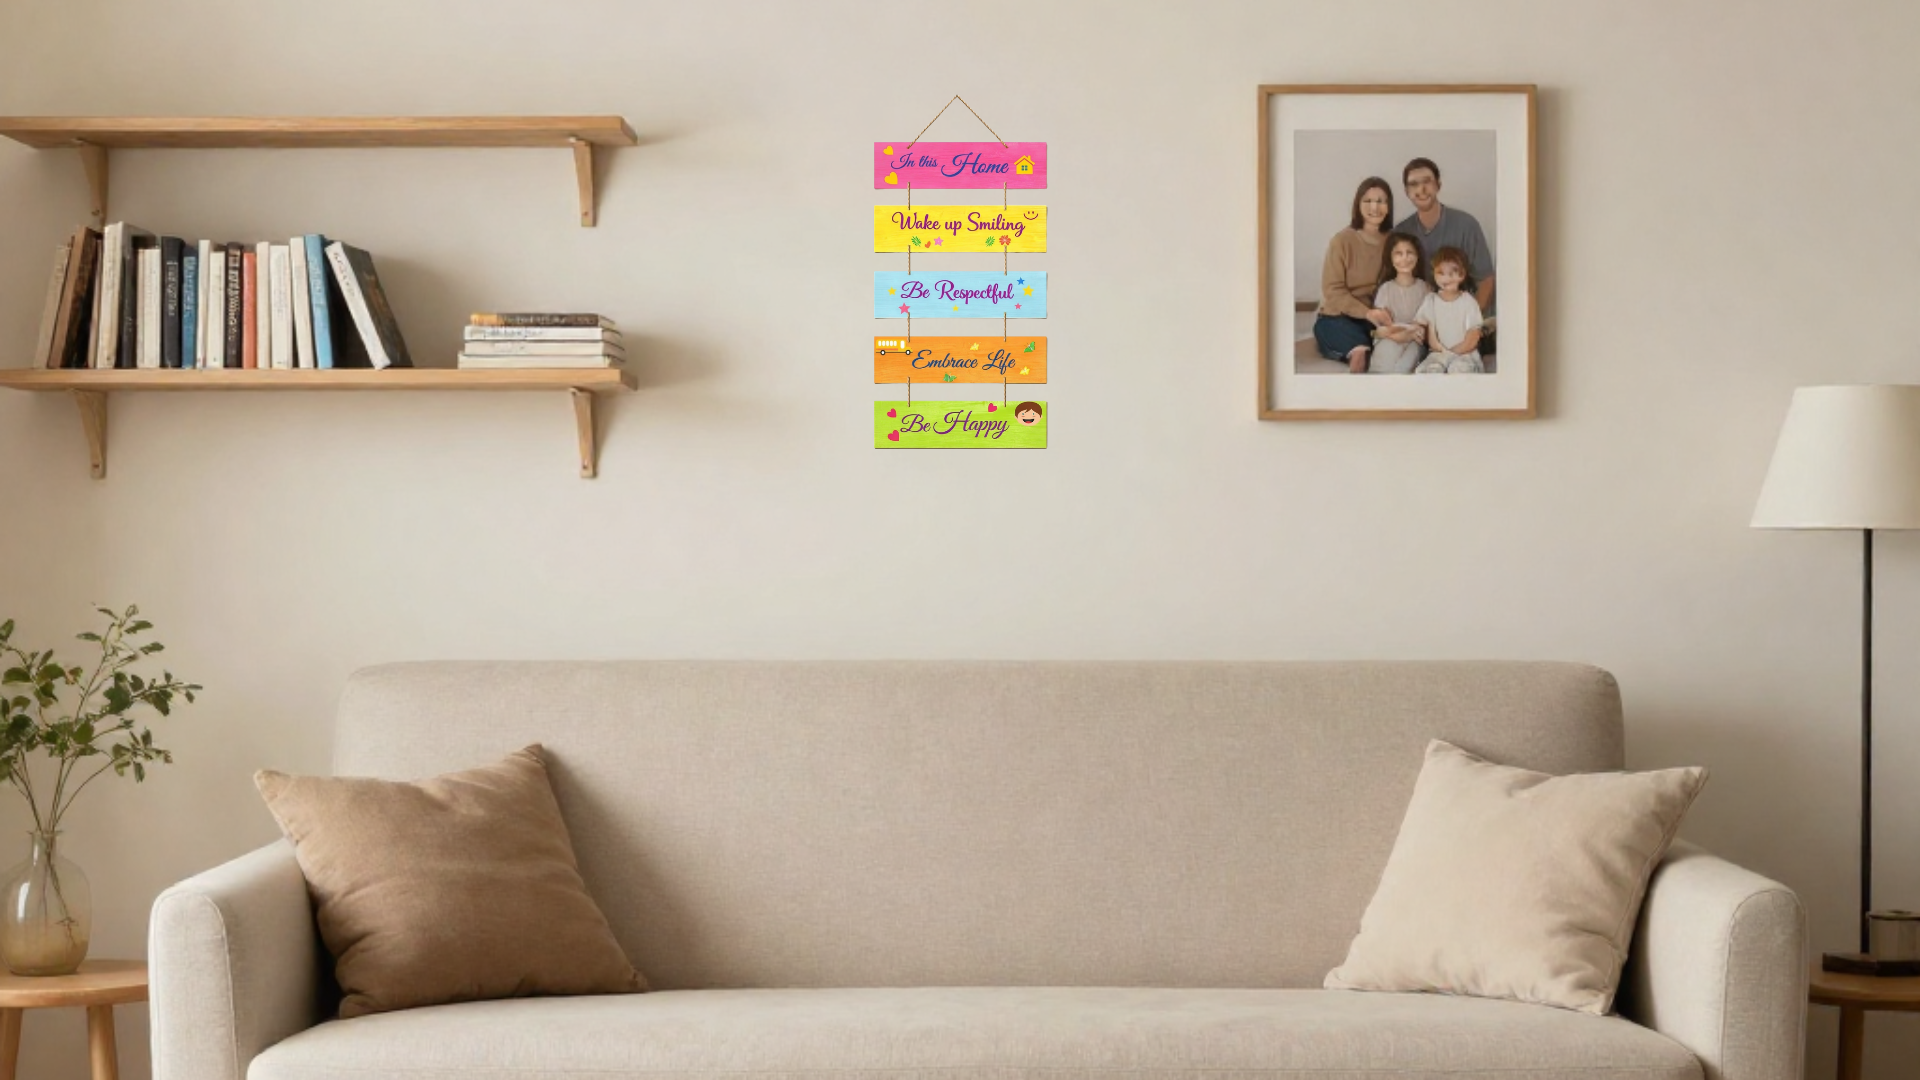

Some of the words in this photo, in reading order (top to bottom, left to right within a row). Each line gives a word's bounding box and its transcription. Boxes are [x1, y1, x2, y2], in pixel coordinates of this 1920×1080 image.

[890, 152, 915, 170] In
[918, 155, 938, 168] this
[940, 152, 1009, 177] Home
[891, 211, 941, 230] Wake
[944, 219, 962, 236] up
[966, 211, 1026, 238] Smiling
[900, 280, 930, 299] Be
[934, 279, 1015, 305] Respectful
[911, 349, 978, 369] Embrace
[981, 348, 1016, 375] Life
[900, 413, 931, 433] Be
[932, 409, 1010, 440] Happy
